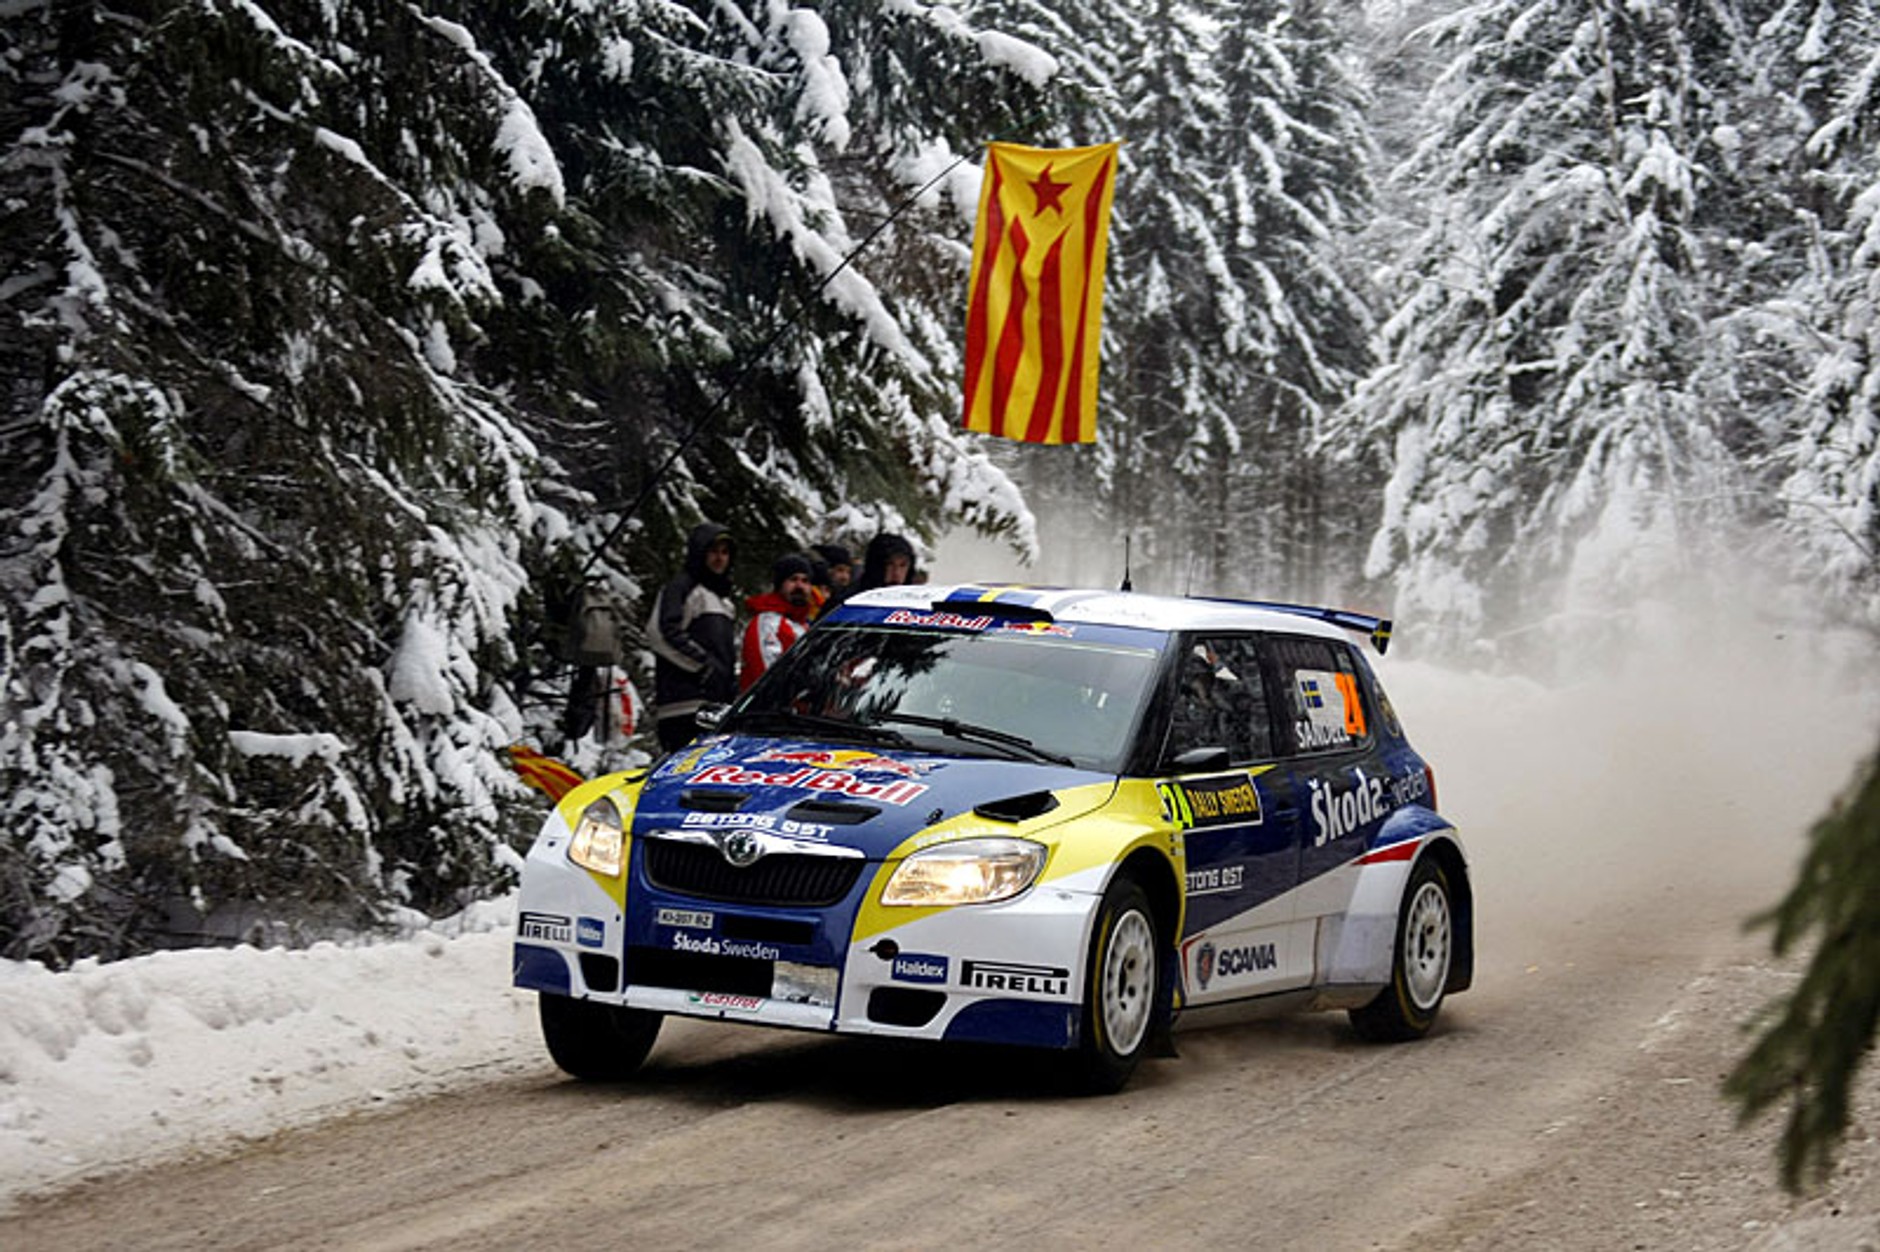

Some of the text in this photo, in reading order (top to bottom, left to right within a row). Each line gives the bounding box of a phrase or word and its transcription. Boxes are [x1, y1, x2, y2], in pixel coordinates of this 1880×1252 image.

[884, 610, 994, 630] Red Bull
[687, 766, 930, 806] Red Bull
[1308, 767, 1384, 847] Škoda
[518, 911, 571, 943] PIRELLI
[673, 931, 779, 960] Škoda Sweden
[1217, 943, 1278, 976] SCANIA
[895, 960, 945, 977] Haldex
[960, 959, 1070, 995] PIRELLI
